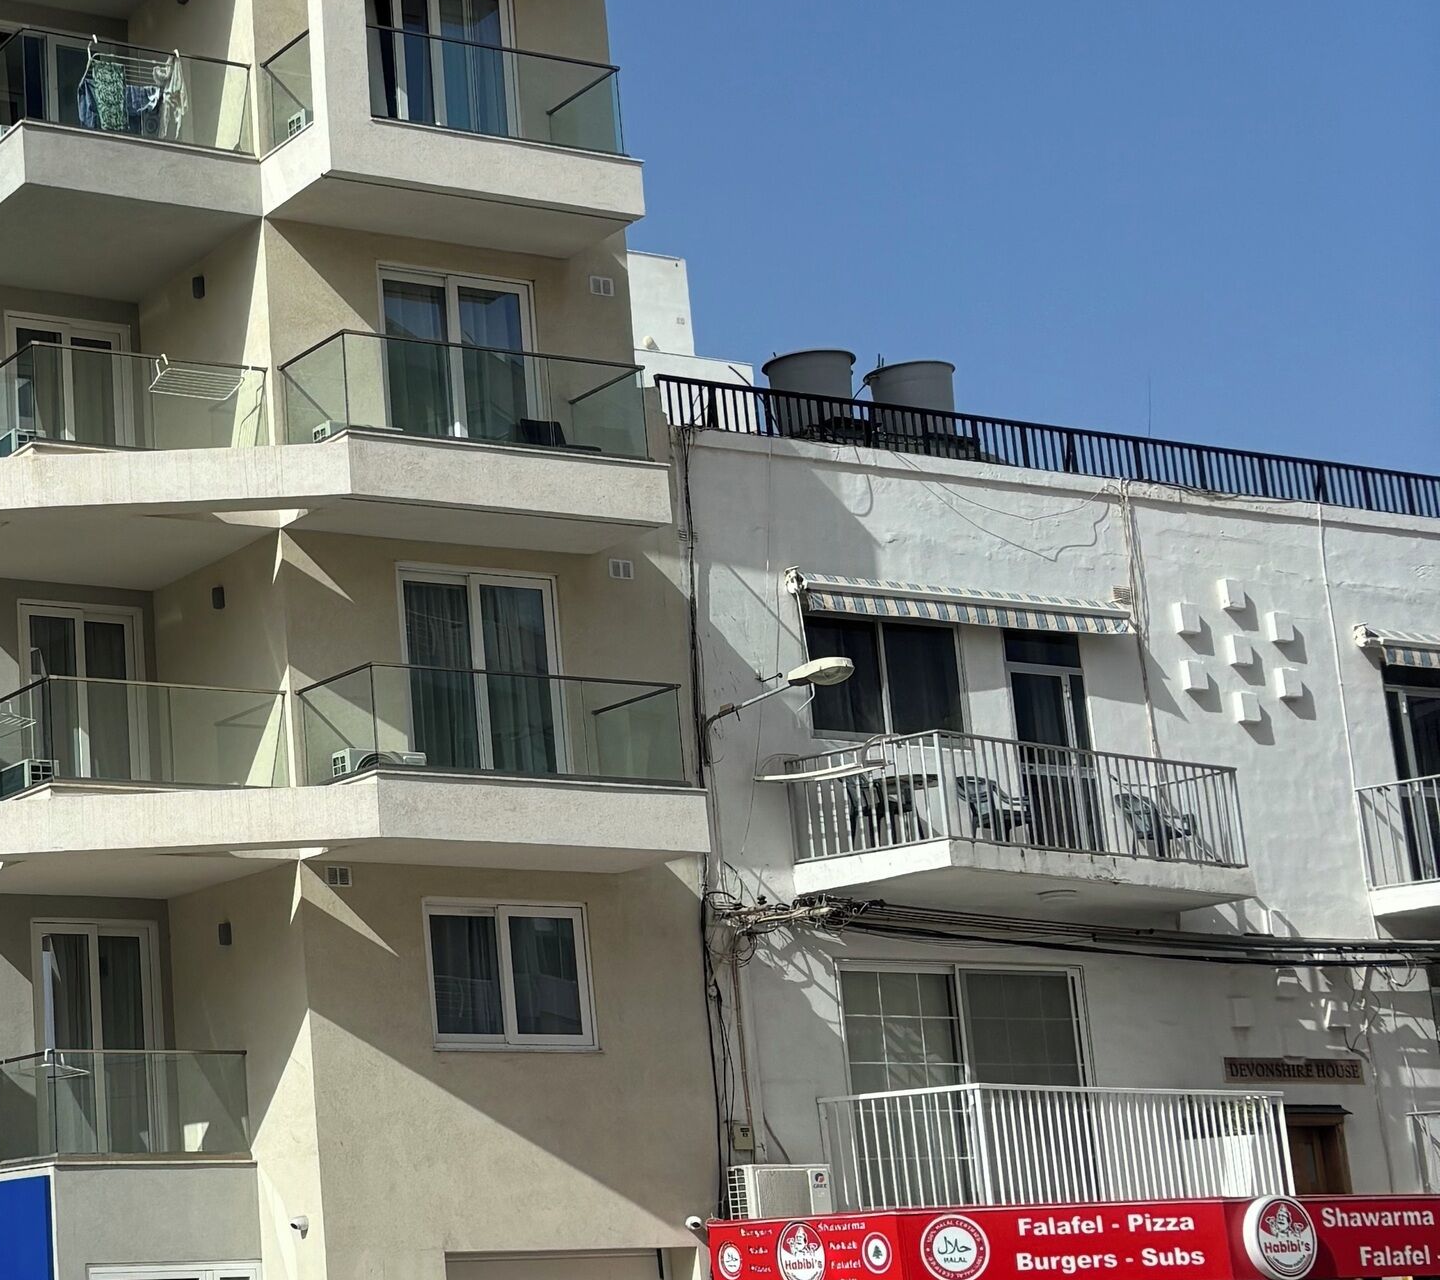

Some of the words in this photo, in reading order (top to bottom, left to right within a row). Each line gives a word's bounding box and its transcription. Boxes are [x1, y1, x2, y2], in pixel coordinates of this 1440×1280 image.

[1230, 1063, 1313, 1079] DEVONSHIRE
[1317, 1064, 1361, 1079] HOUSE
[1017, 1215, 1104, 1236] Falafel
[1127, 1213, 1195, 1233] Pizza
[1321, 1207, 1435, 1228] Shawarma
[817, 1222, 866, 1232] Shawarma
[937, 1236, 972, 1255] حلال
[1264, 1239, 1311, 1253] Habibi's
[784, 1257, 823, 1271] Habibi's
[943, 1256, 968, 1264] HALAL
[1016, 1252, 1118, 1275] Burgers
[1141, 1247, 1206, 1267] Subs
[1360, 1245, 1431, 1267] Falafel
[831, 1259, 862, 1270] Falafel
